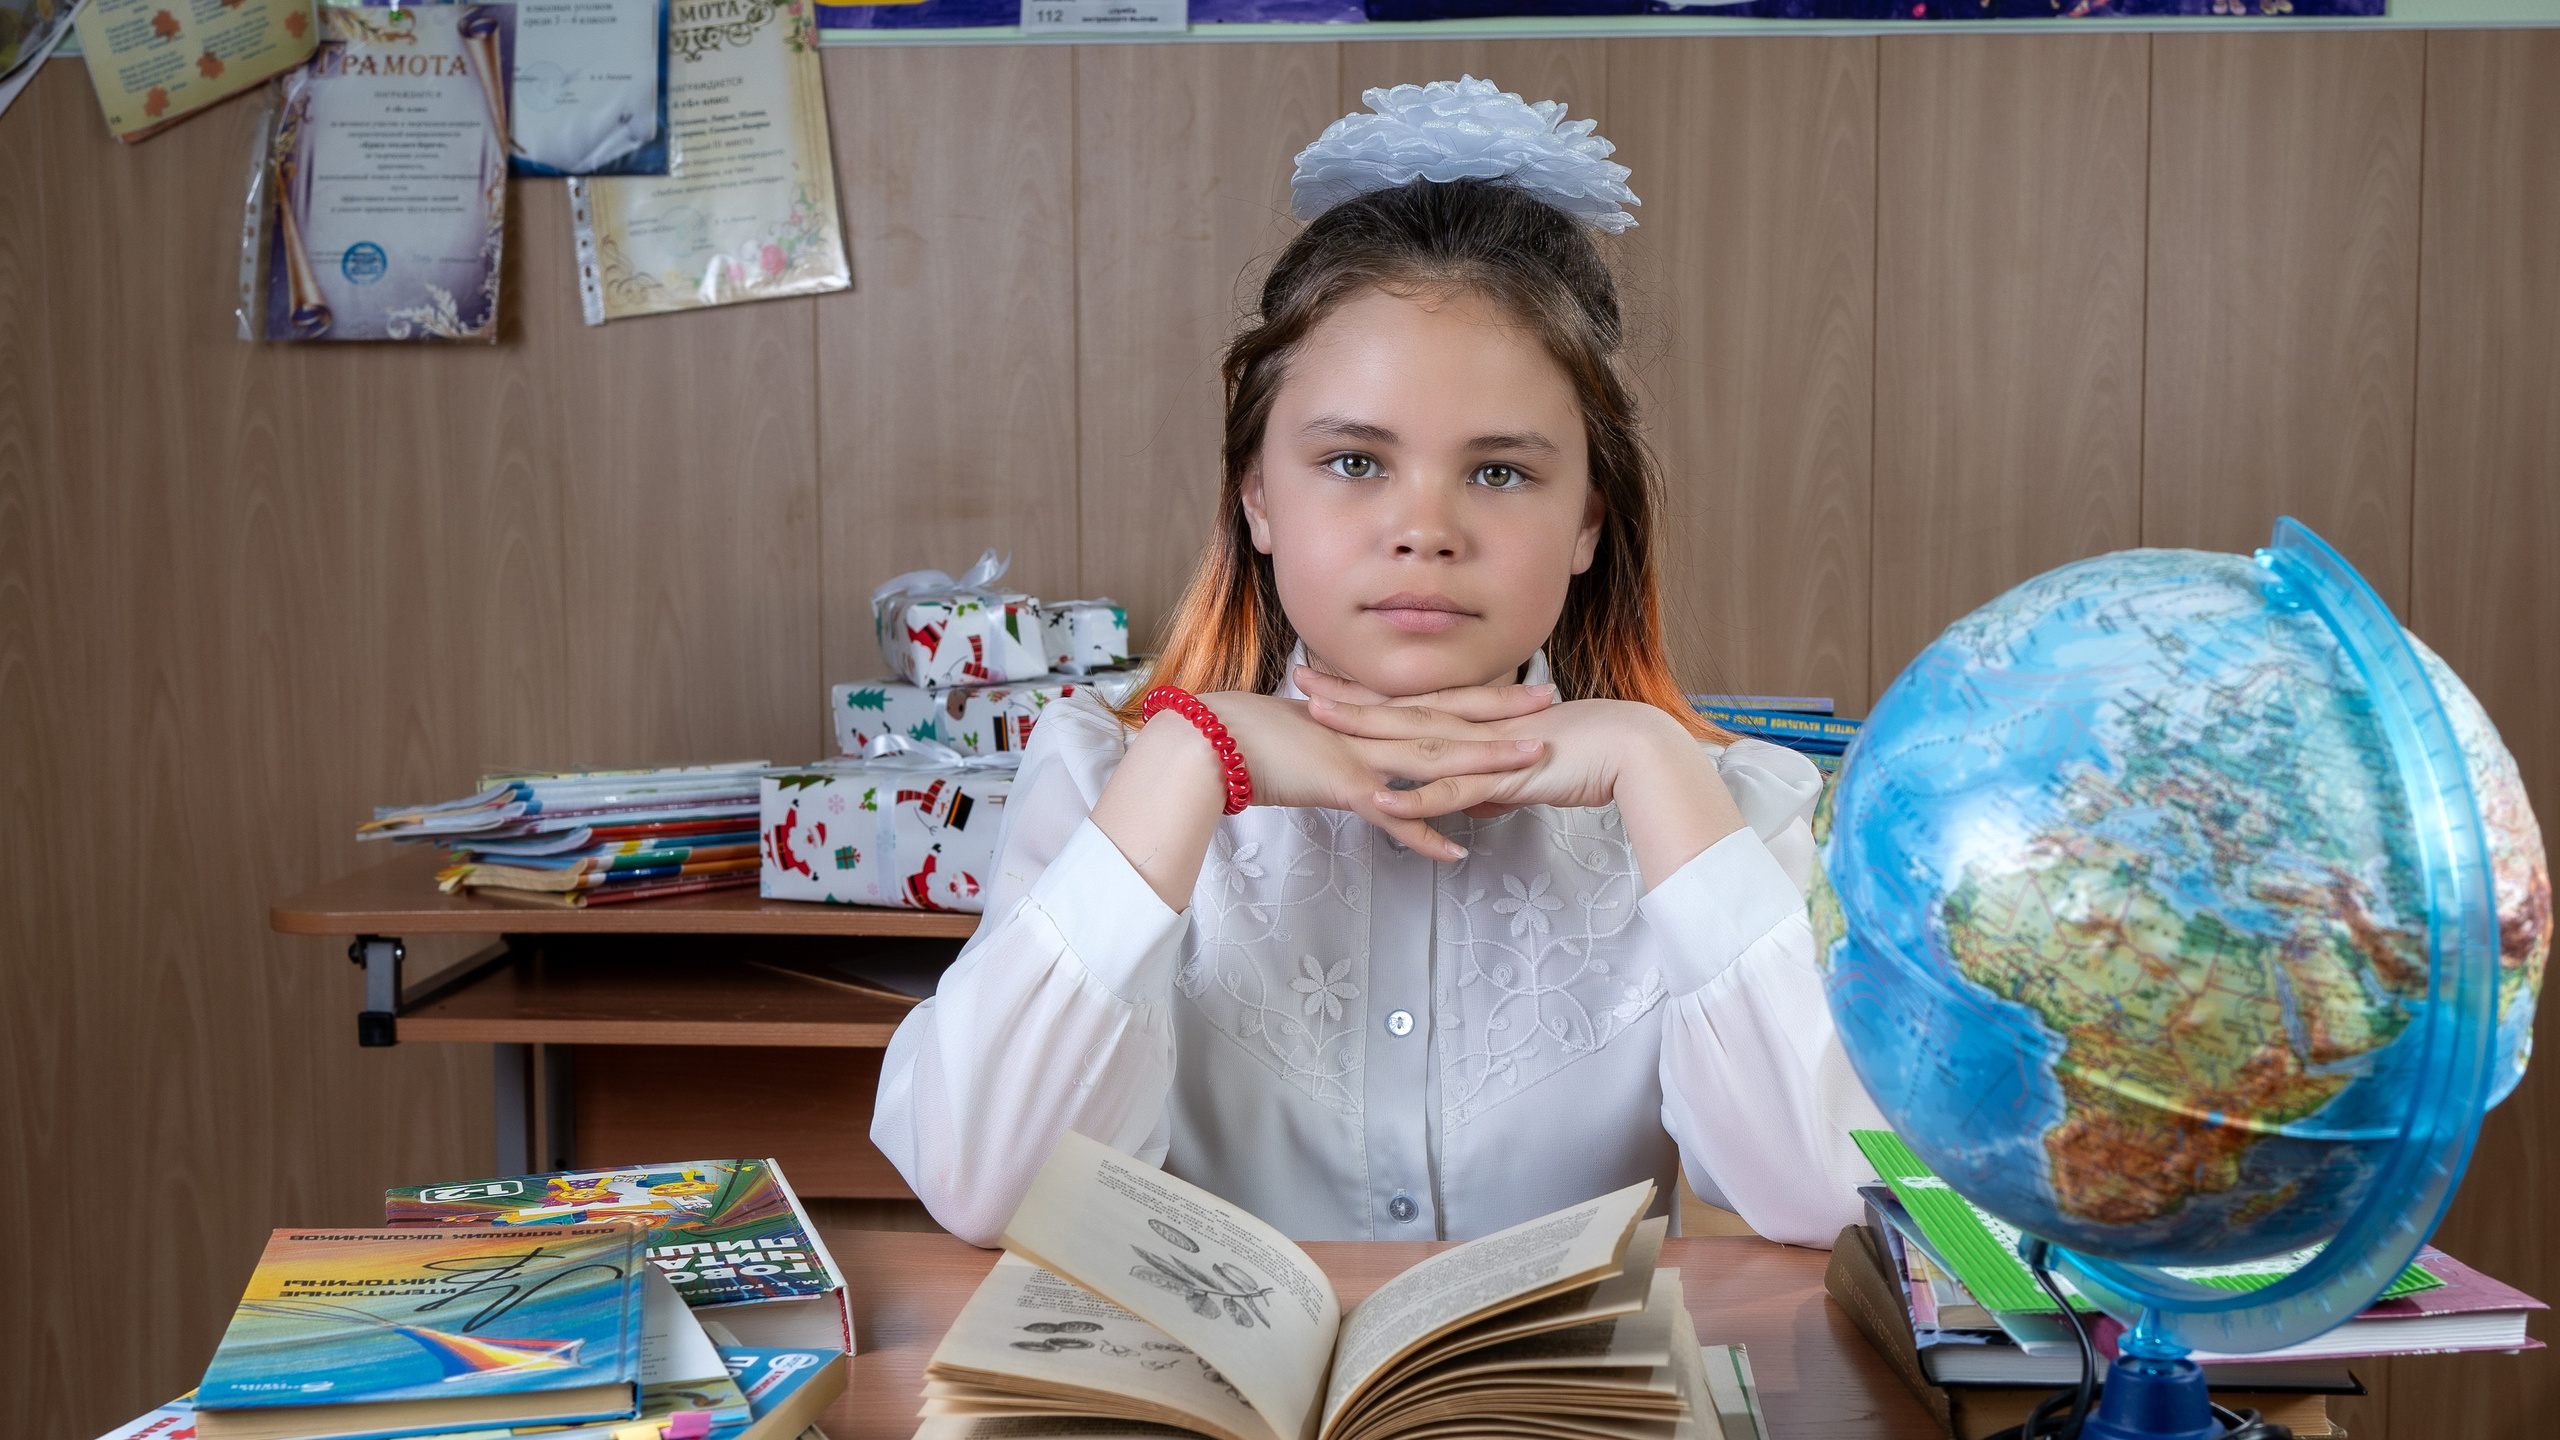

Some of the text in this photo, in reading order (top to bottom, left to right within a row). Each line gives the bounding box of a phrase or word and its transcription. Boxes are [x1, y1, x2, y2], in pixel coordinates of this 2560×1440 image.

[670, 0, 739, 22] МОТА
[1035, 9, 1064, 23] 112
[316, 41, 468, 77] ГРАМОТА
[1770, 717, 1820, 732] НАЧАЛЬНОЙ
[452, 1230, 563, 1240] МЛАДШИХ
[571, 1227, 616, 1236] ДЛЯ
